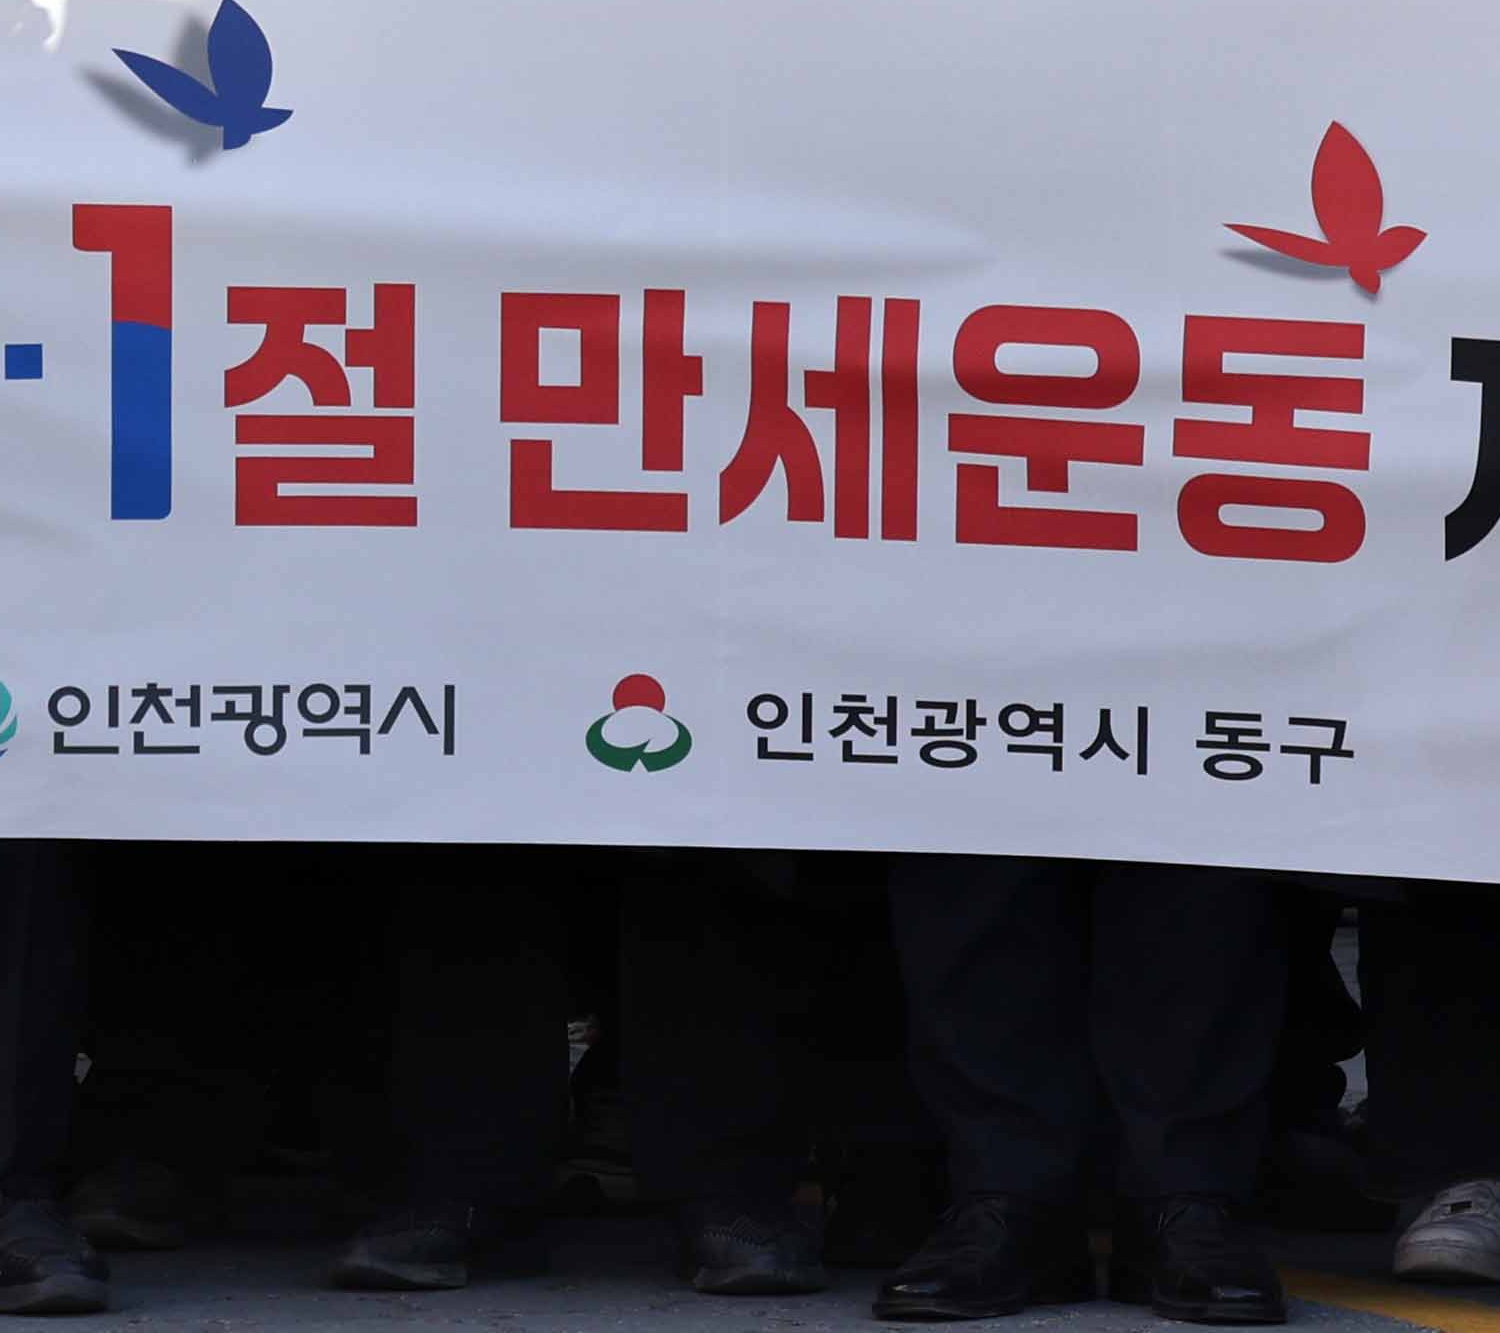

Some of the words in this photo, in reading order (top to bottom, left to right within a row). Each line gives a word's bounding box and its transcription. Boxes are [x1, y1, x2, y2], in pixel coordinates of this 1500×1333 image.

[500, 288, 1372, 563] 만세운동
[47, 682, 456, 756] 인천광역시
[745, 692, 1150, 776] 인천광역시
[1195, 710, 1355, 785] 동구
